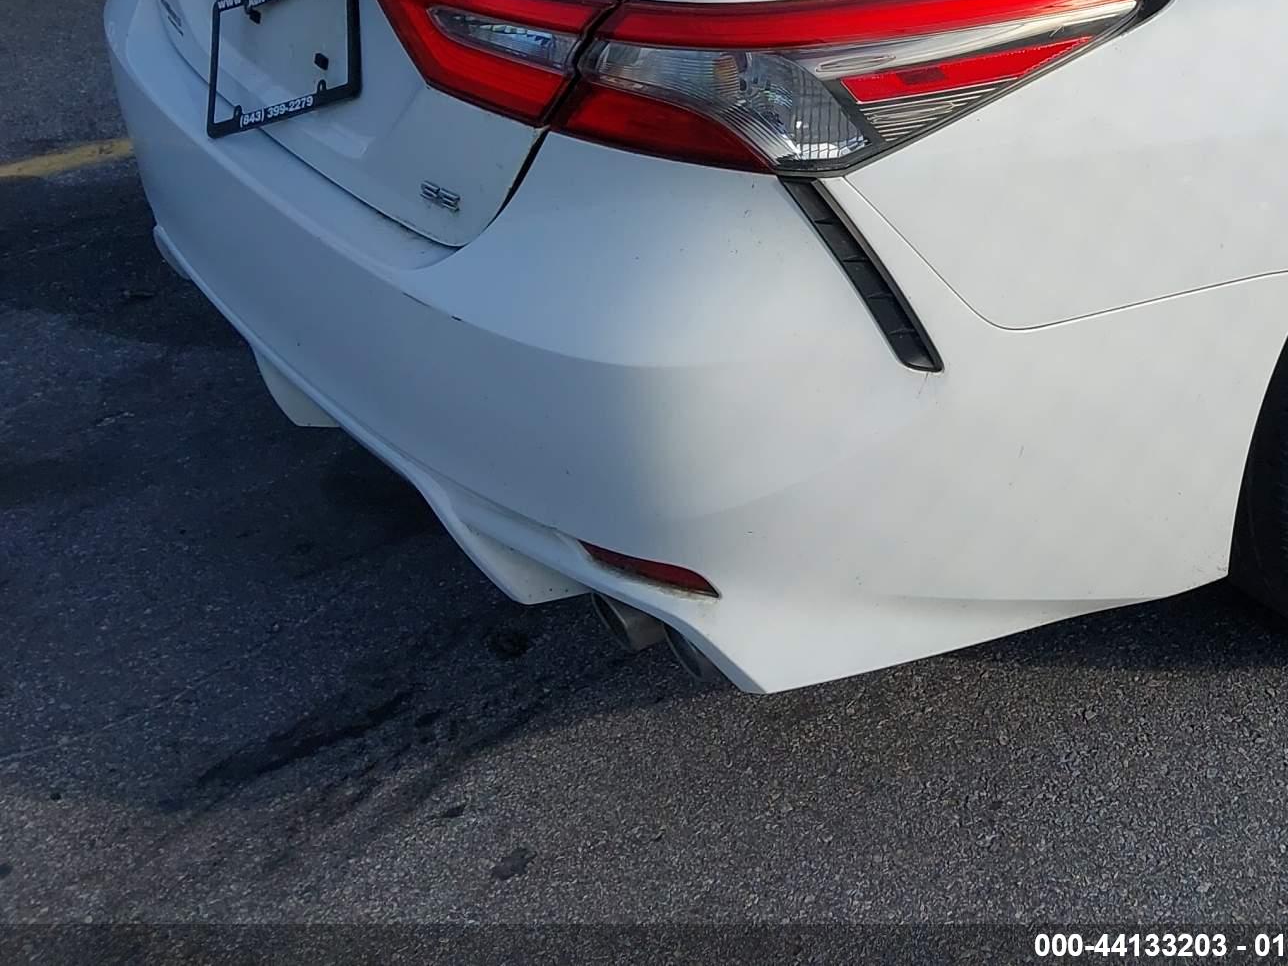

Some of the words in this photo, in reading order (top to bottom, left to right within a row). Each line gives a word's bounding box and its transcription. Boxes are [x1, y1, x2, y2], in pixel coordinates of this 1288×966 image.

[239, 107, 265, 128] (843)
[266, 95, 314, 119] 399-2279
[420, 180, 460, 212] SE
